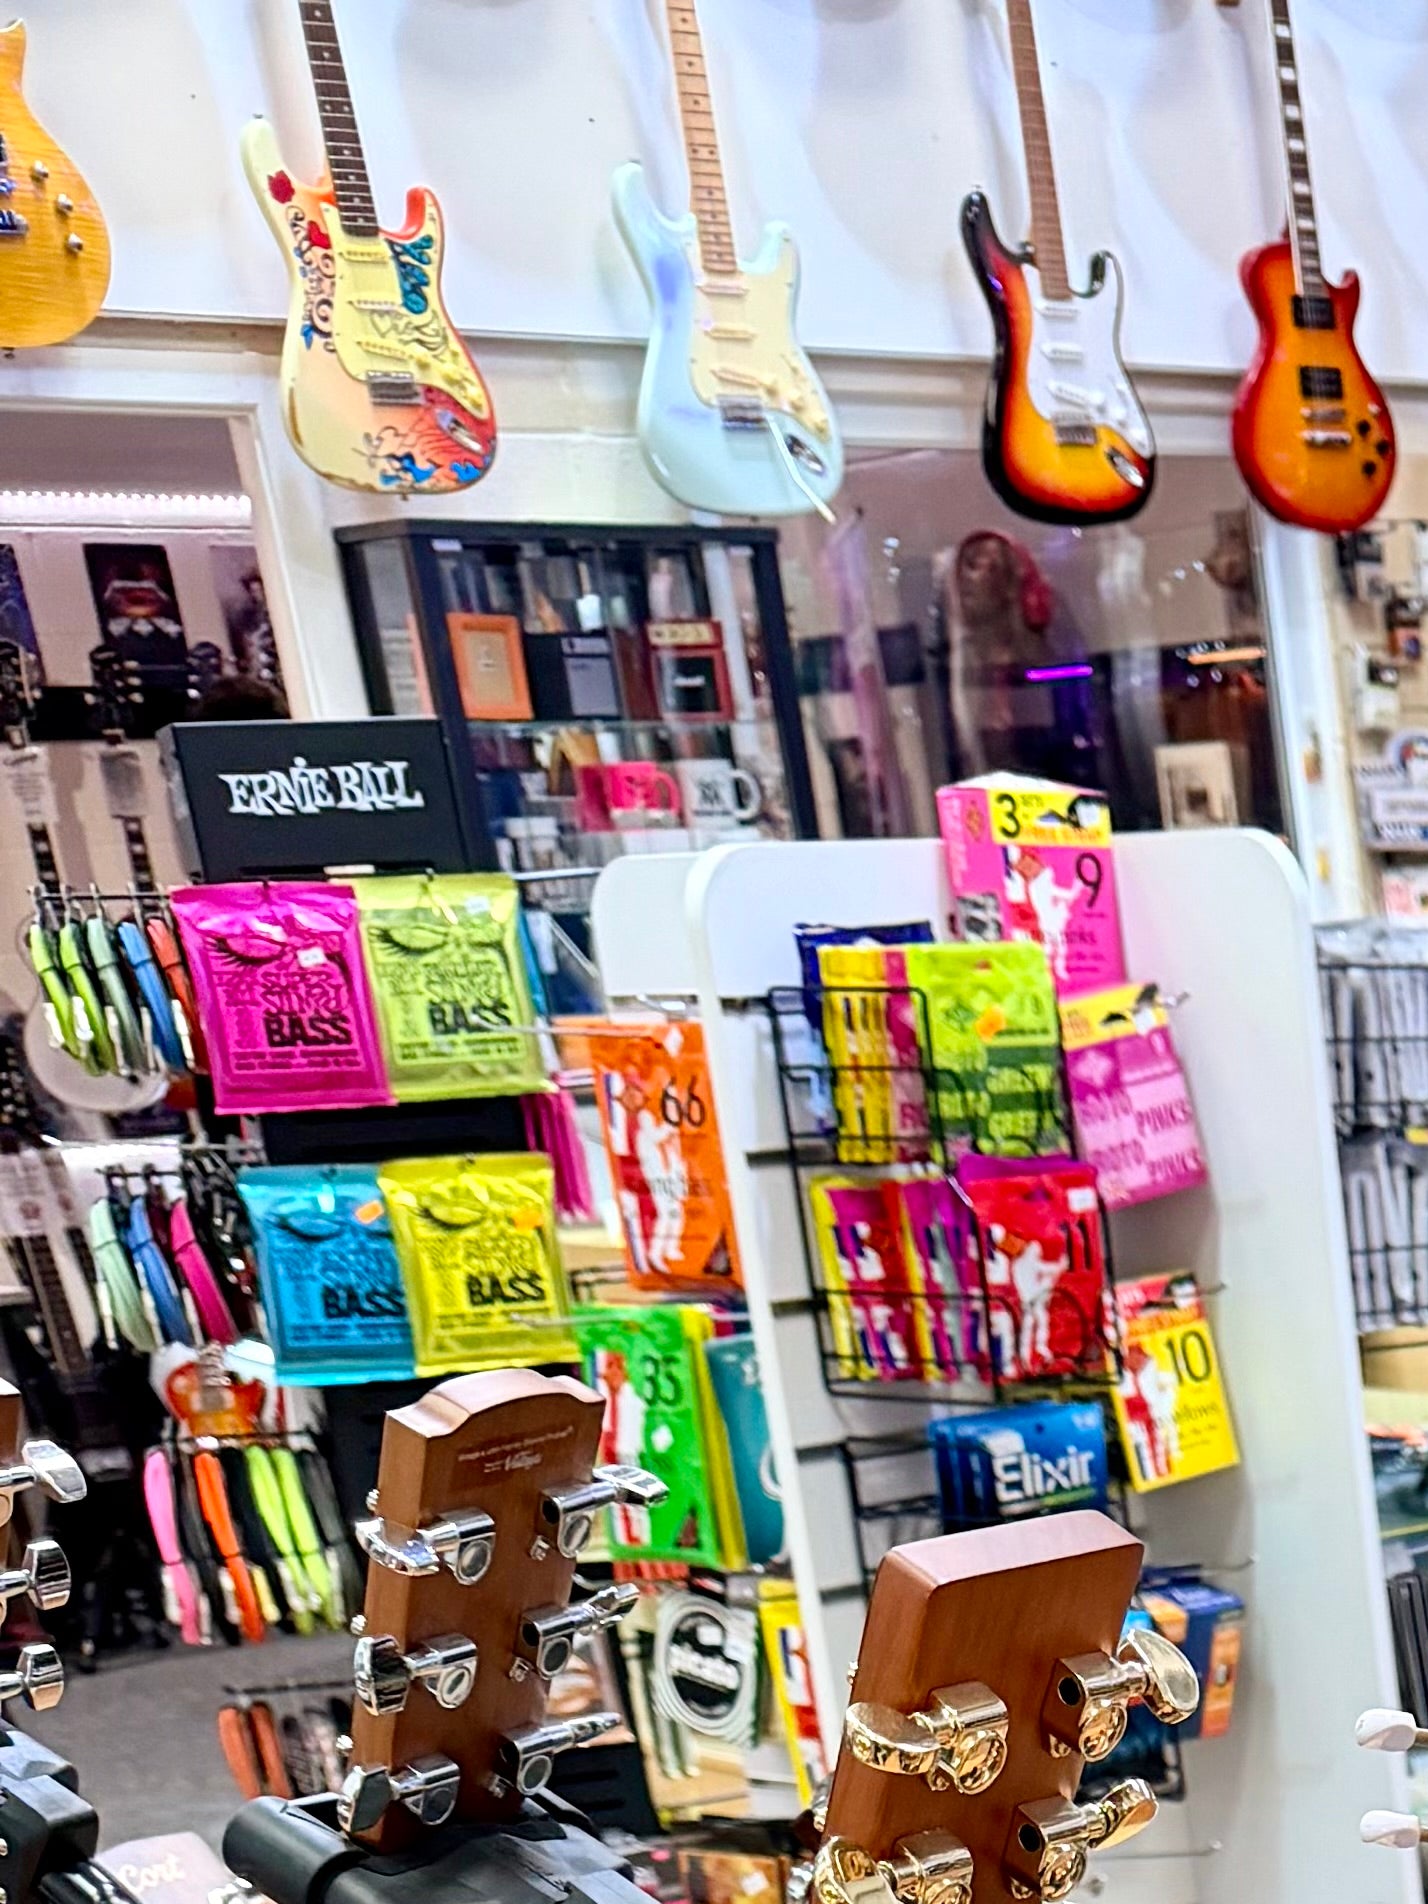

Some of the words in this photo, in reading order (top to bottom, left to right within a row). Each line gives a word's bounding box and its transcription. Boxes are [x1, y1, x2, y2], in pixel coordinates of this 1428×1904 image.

[218, 756, 336, 815] ERNIE
[338, 757, 425, 812] BALL
[999, 793, 1022, 839] 3
[1074, 852, 1104, 908] 9
[264, 1013, 353, 1048] BASS
[428, 999, 513, 1035] BASS
[661, 1075, 706, 1128] 66
[320, 1284, 404, 1320] BASS
[467, 1271, 546, 1306] BASS
[641, 1355, 684, 1407] 35
[1165, 1330, 1212, 1386] 10
[991, 1444, 1096, 1502] Elixir
